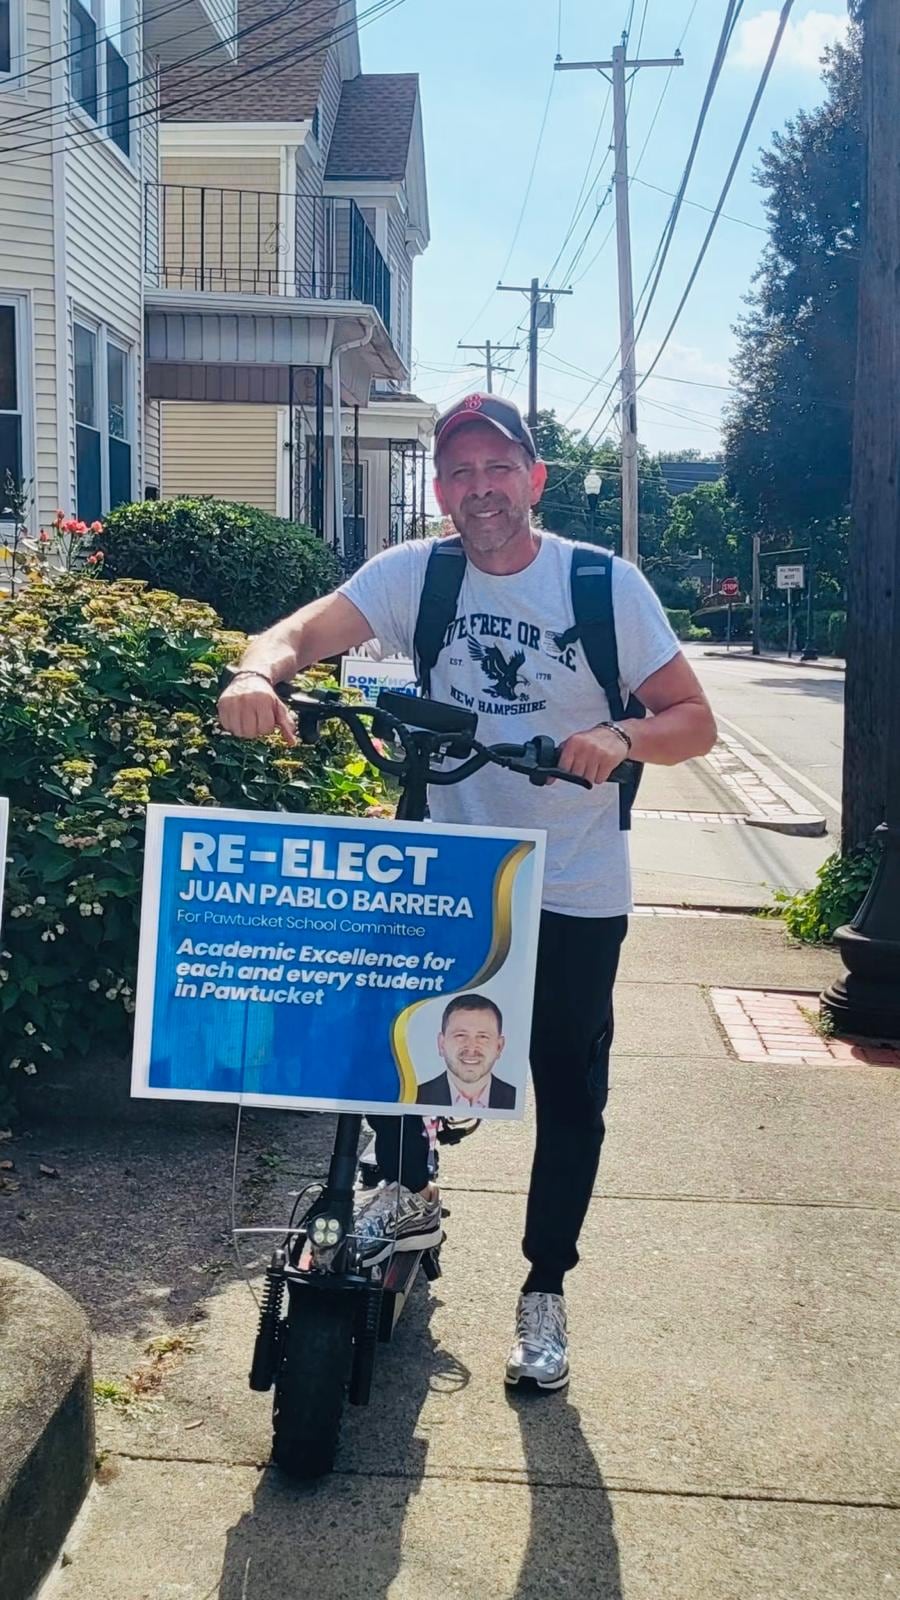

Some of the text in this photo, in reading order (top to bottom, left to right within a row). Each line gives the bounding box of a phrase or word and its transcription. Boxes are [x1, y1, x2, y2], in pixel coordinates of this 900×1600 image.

[470, 613, 512, 641] FREE
[517, 621, 541, 651] OR
[347, 675, 378, 685] DON
[450, 685, 547, 716] NEW HAMPSHIRE
[181, 832, 438, 885] RE-ELECT
[179, 880, 474, 919] JUAN PABLO BARRERA
[177, 909, 426, 937] For Pawtucket School Committee
[176, 937, 456, 972] Academic Excellence for
[175, 960, 445, 992] each and every student
[175, 979, 325, 1006] in Pawtucket
